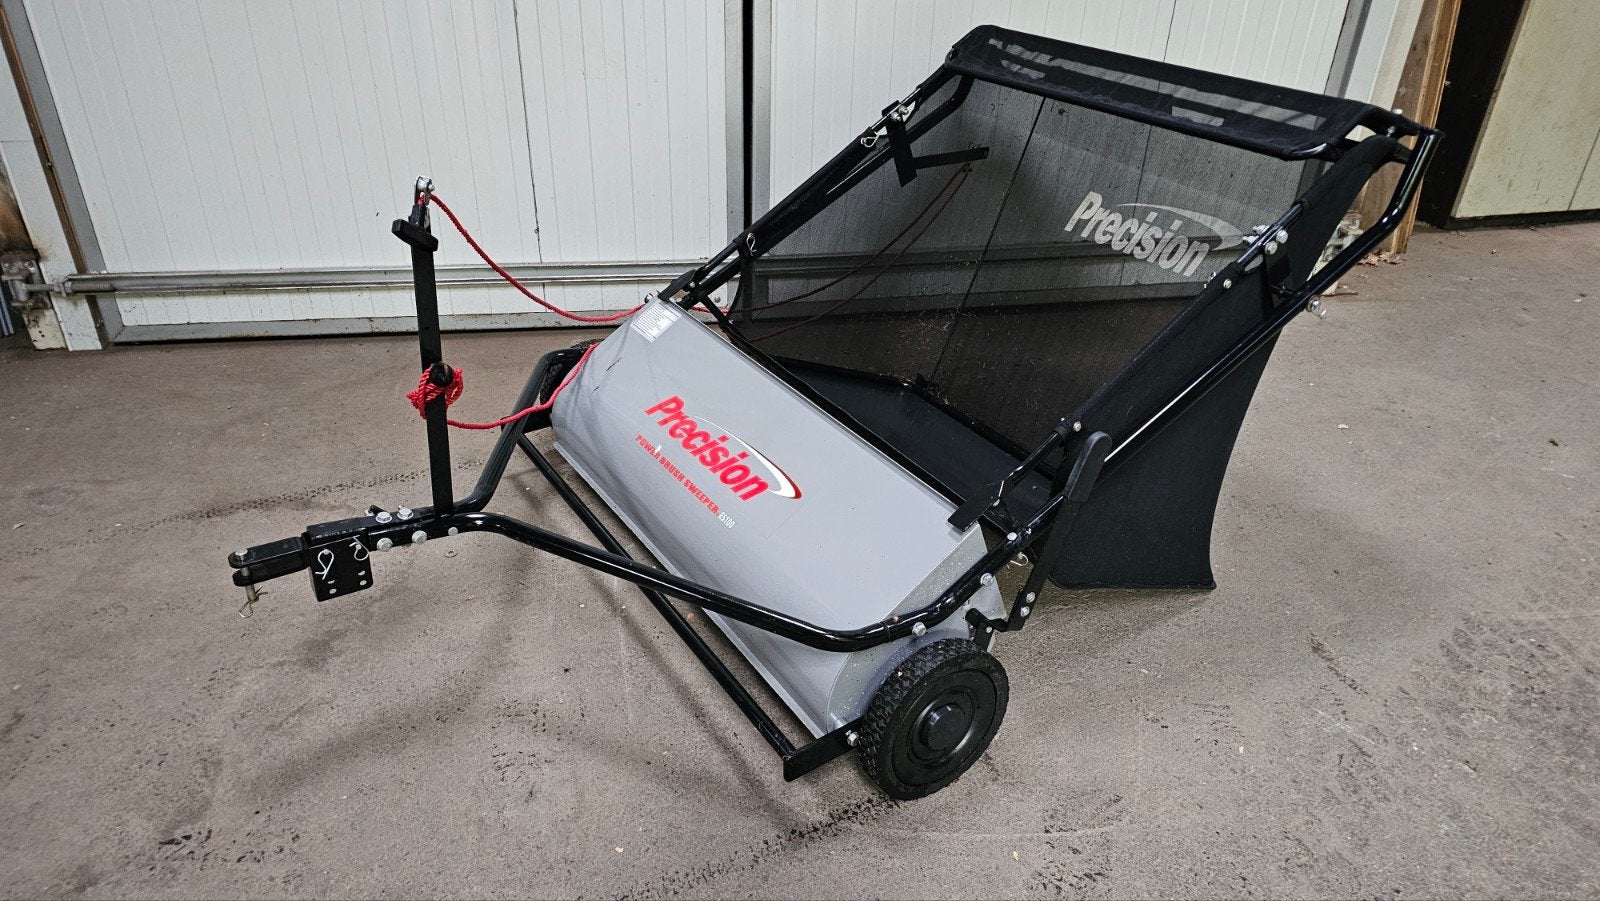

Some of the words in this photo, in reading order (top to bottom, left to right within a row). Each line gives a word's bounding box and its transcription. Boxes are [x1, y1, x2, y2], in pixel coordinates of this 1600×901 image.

[1065, 191, 1209, 277] Precision
[645, 395, 769, 501] Precision
[659, 456, 685, 482] BRUSH
